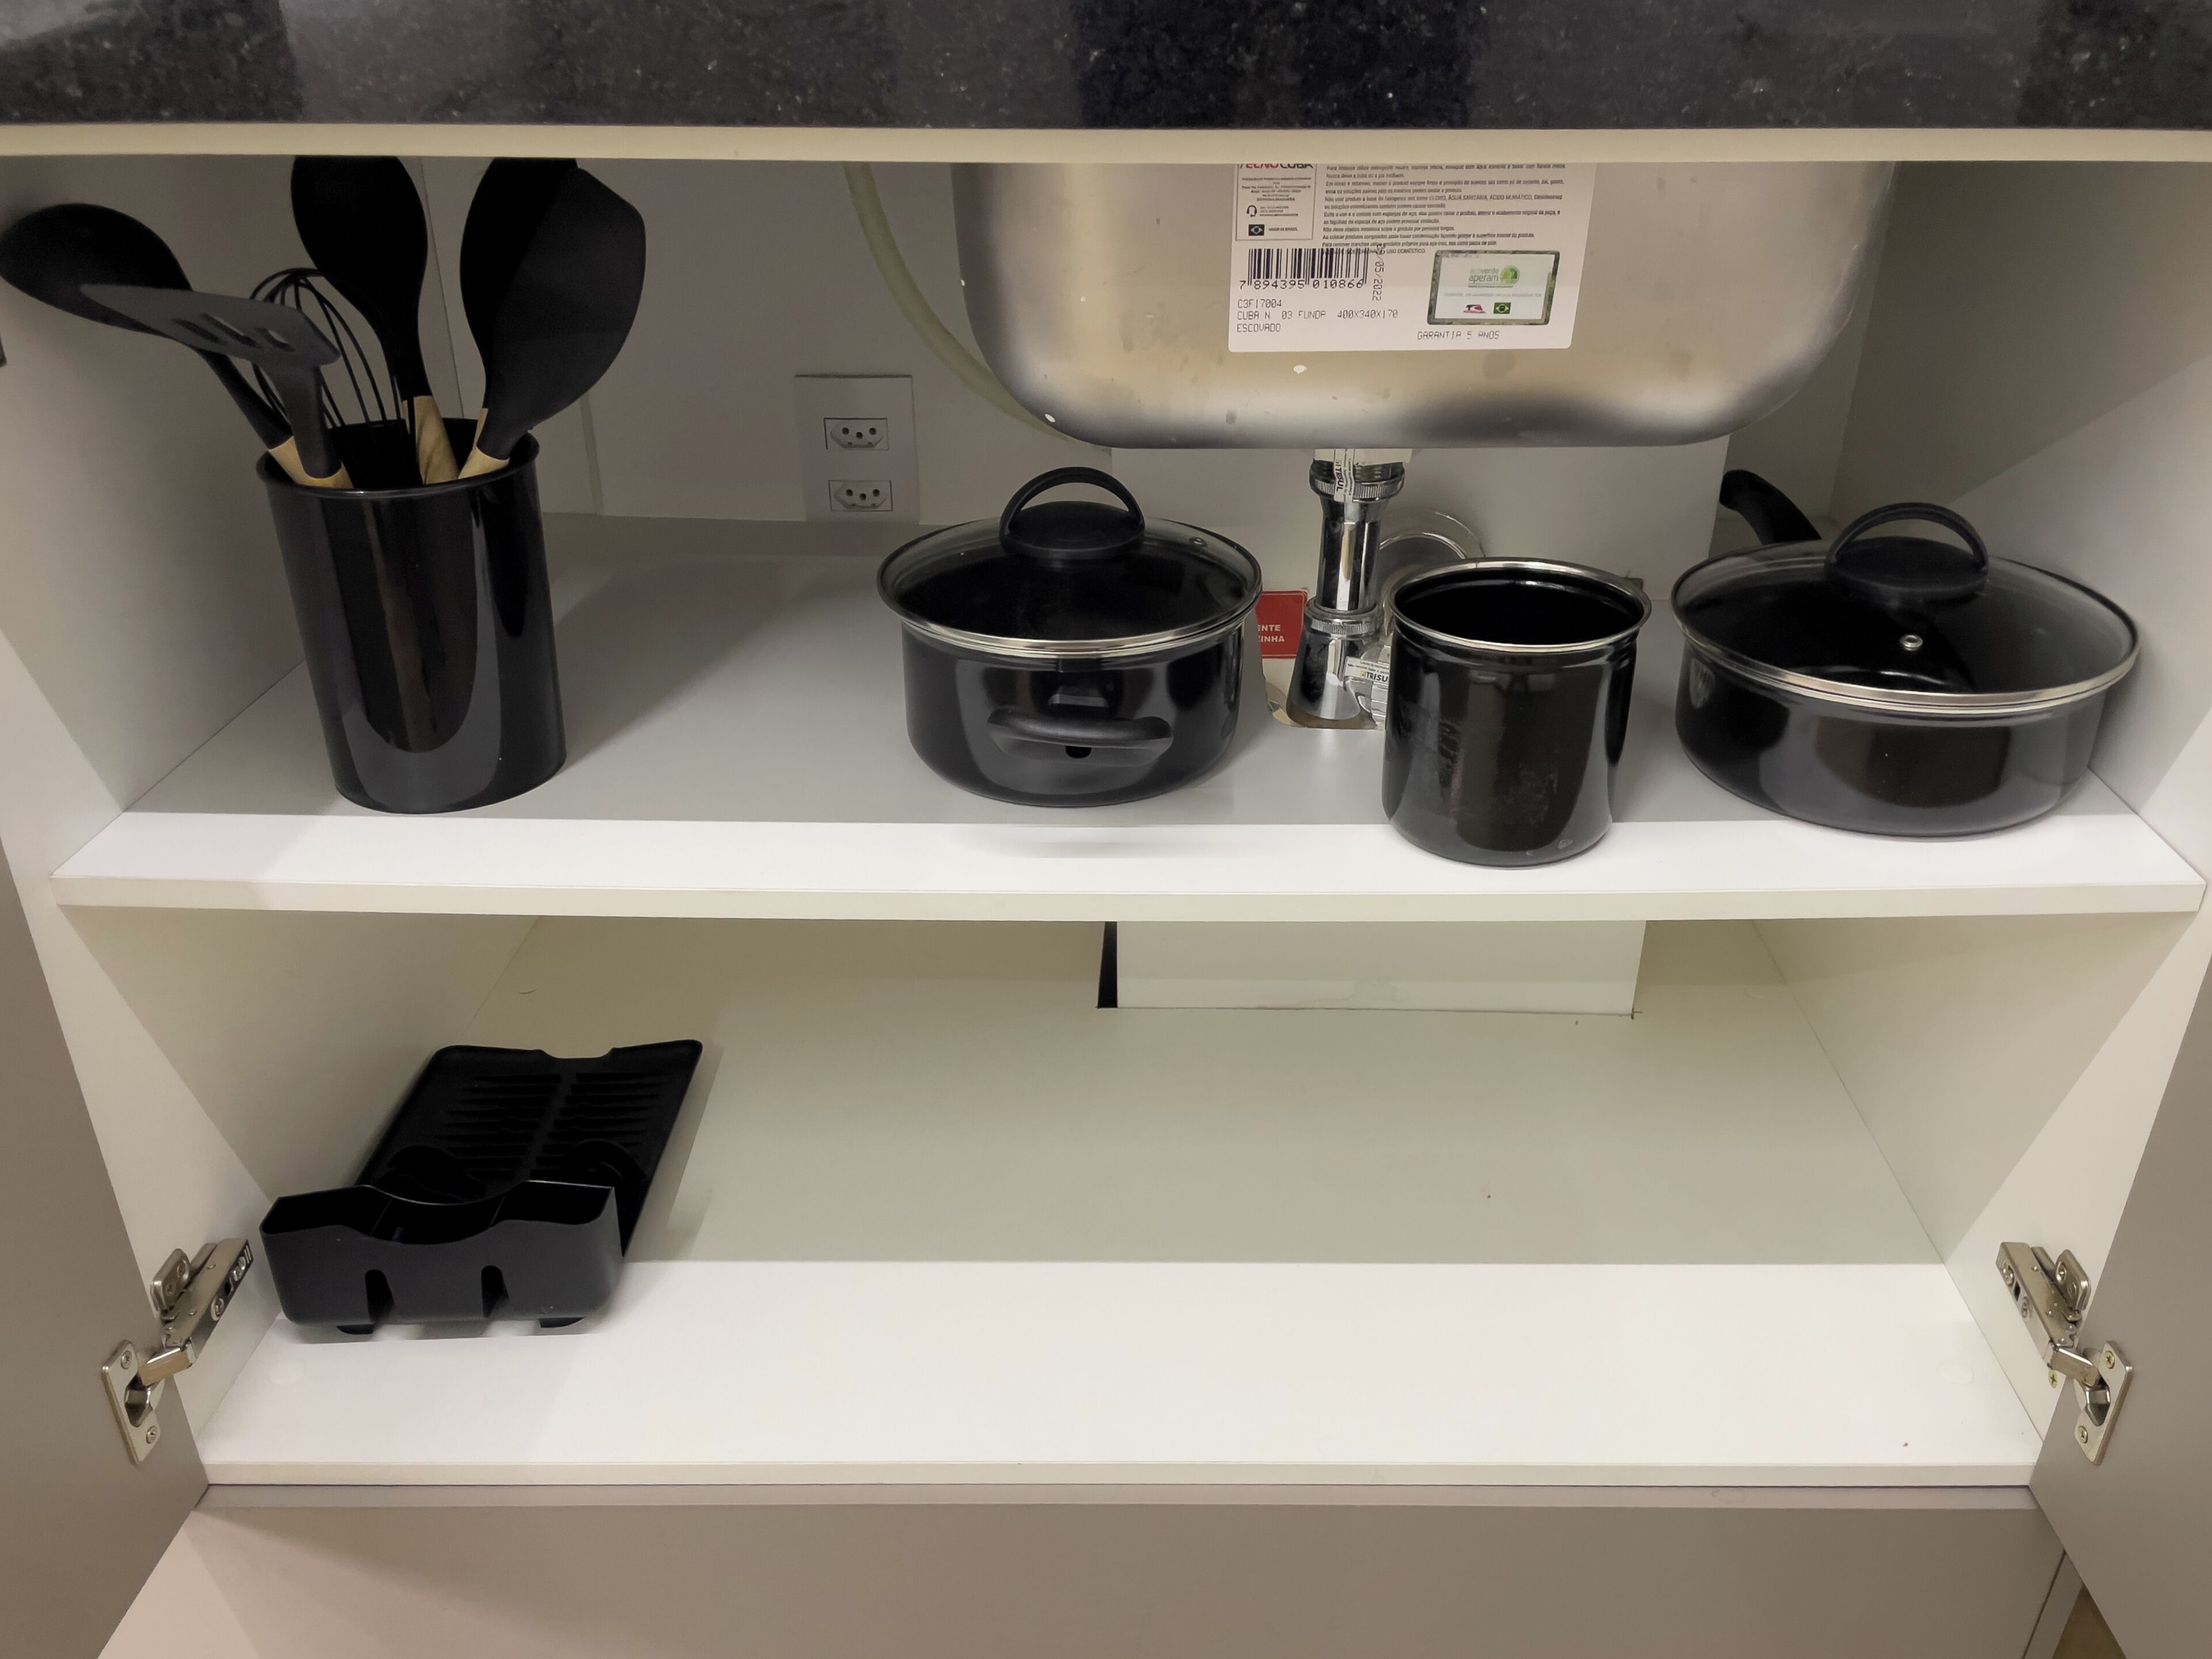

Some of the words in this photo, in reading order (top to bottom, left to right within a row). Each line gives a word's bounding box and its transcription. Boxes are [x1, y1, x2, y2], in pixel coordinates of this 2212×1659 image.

[1469, 275, 1499, 284] aperam
[1239, 281, 1246, 290] 7
[1254, 280, 1305, 289] 894395
[1313, 279, 1363, 289] 010866
[1237, 311, 1259, 320] CUBA
[1264, 311, 1270, 319] N
[1282, 310, 1293, 319] 03
[1237, 323, 1281, 332] ESCOVADO
[1417, 331, 1461, 340] GARANTIA
[1467, 331, 1472, 339] 5
[1478, 331, 1500, 339] ANOS
